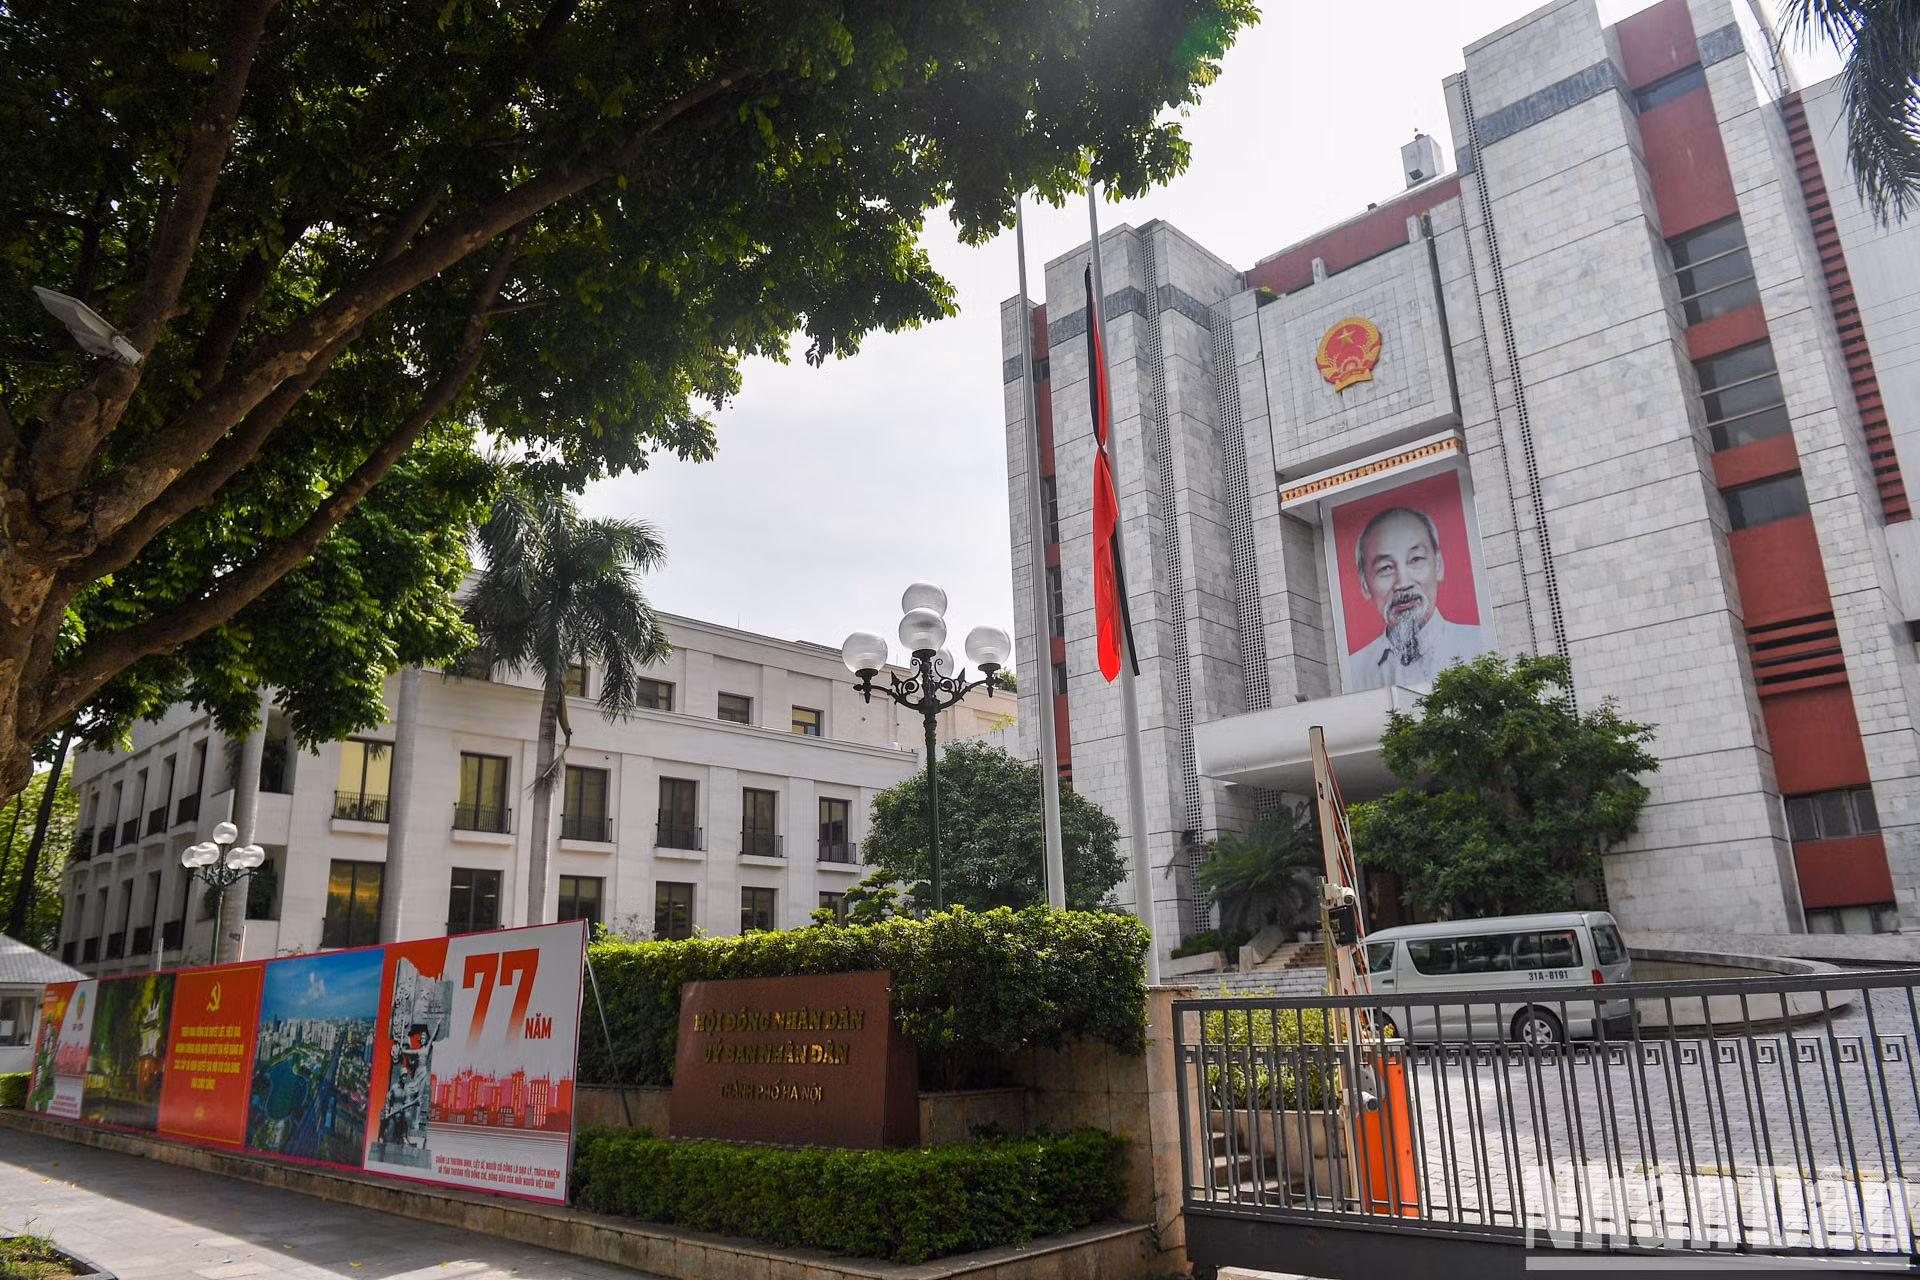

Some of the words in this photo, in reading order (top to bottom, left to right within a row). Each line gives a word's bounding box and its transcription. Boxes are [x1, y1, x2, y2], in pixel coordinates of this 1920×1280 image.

[463, 948, 540, 1047] 77
[525, 1012, 552, 1039] NĂM
[694, 1008, 723, 1036] HỘI
[773, 1006, 822, 1031] NHÂN
[825, 1005, 865, 1030] DÂN
[724, 1044, 758, 1064] BAN
[760, 1040, 808, 1064] NHÂN
[811, 1039, 850, 1064] DÂN
[719, 1079, 755, 1099] THÀNH
[757, 1079, 782, 1100] PHỐ
[801, 1082, 823, 1105] NỘI
